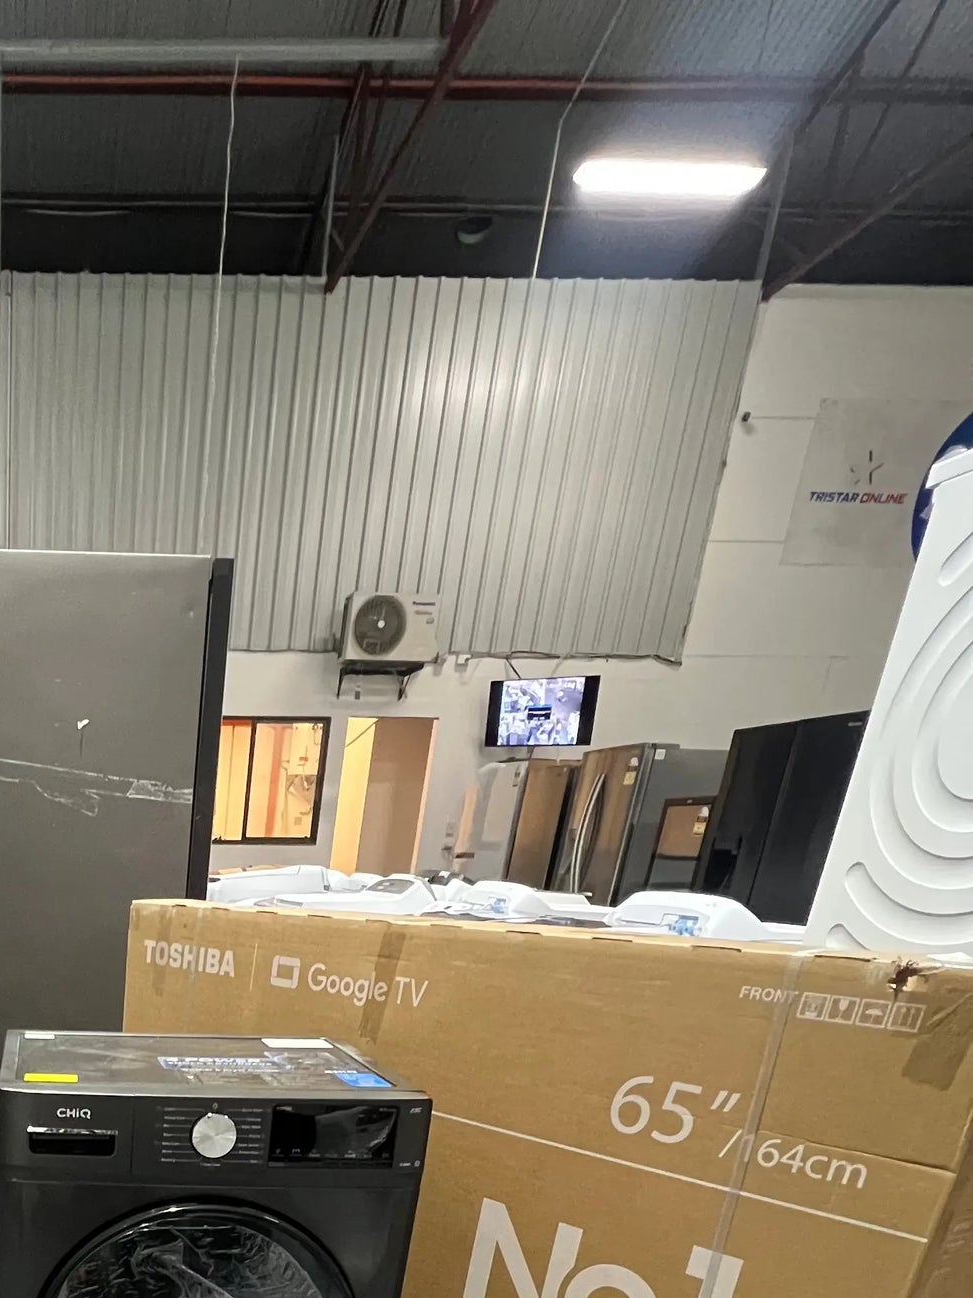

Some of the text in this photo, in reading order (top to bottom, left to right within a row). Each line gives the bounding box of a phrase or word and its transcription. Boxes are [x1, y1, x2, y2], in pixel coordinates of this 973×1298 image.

[809, 491, 908, 504] TRISTAR ONLINE
[144, 940, 235, 978] TOSHIBA
[307, 962, 429, 1007] Google TV
[739, 985, 798, 1004] FRONT
